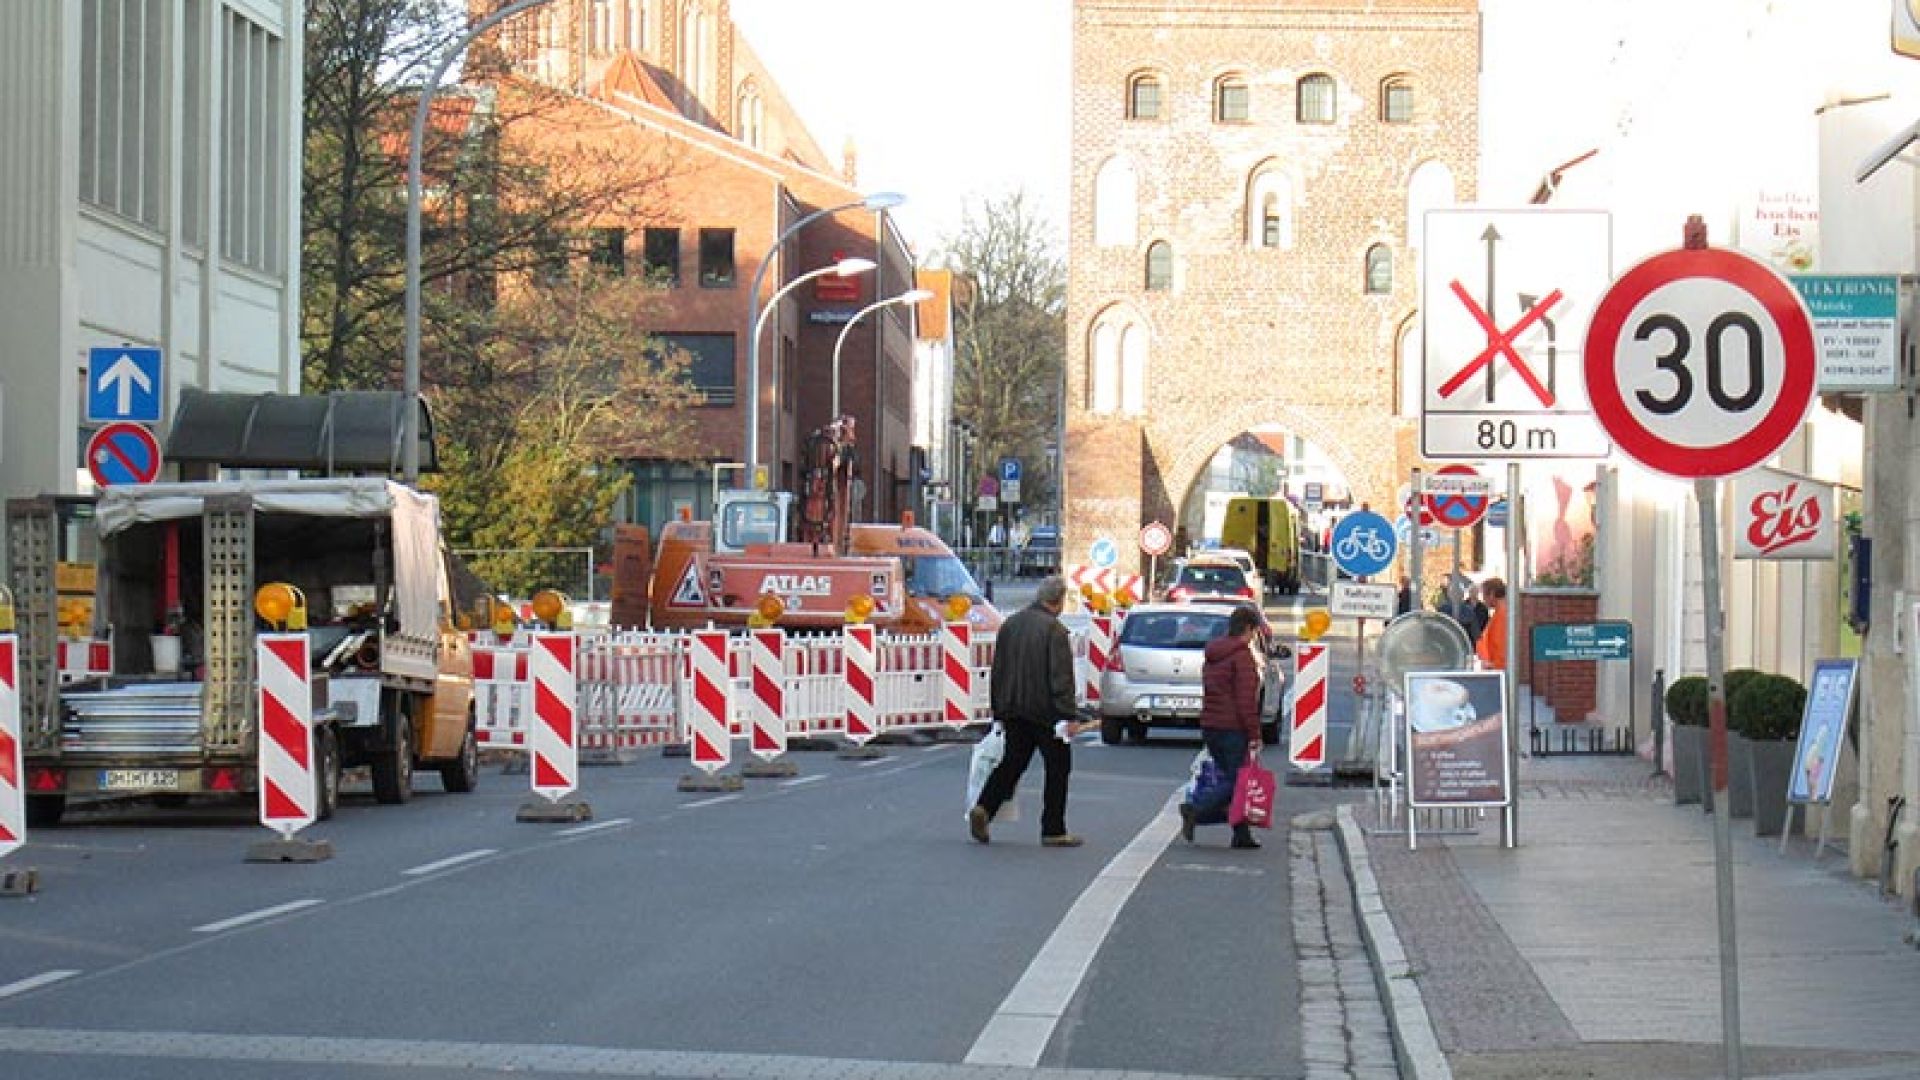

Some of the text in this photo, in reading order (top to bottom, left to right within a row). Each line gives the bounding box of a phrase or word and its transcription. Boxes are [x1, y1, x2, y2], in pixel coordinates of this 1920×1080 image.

[1634, 311, 1765, 414] 30
[1478, 420, 1556, 449] 80 m
[1747, 482, 1821, 553] Eis
[760, 574, 832, 595] ATLAS
